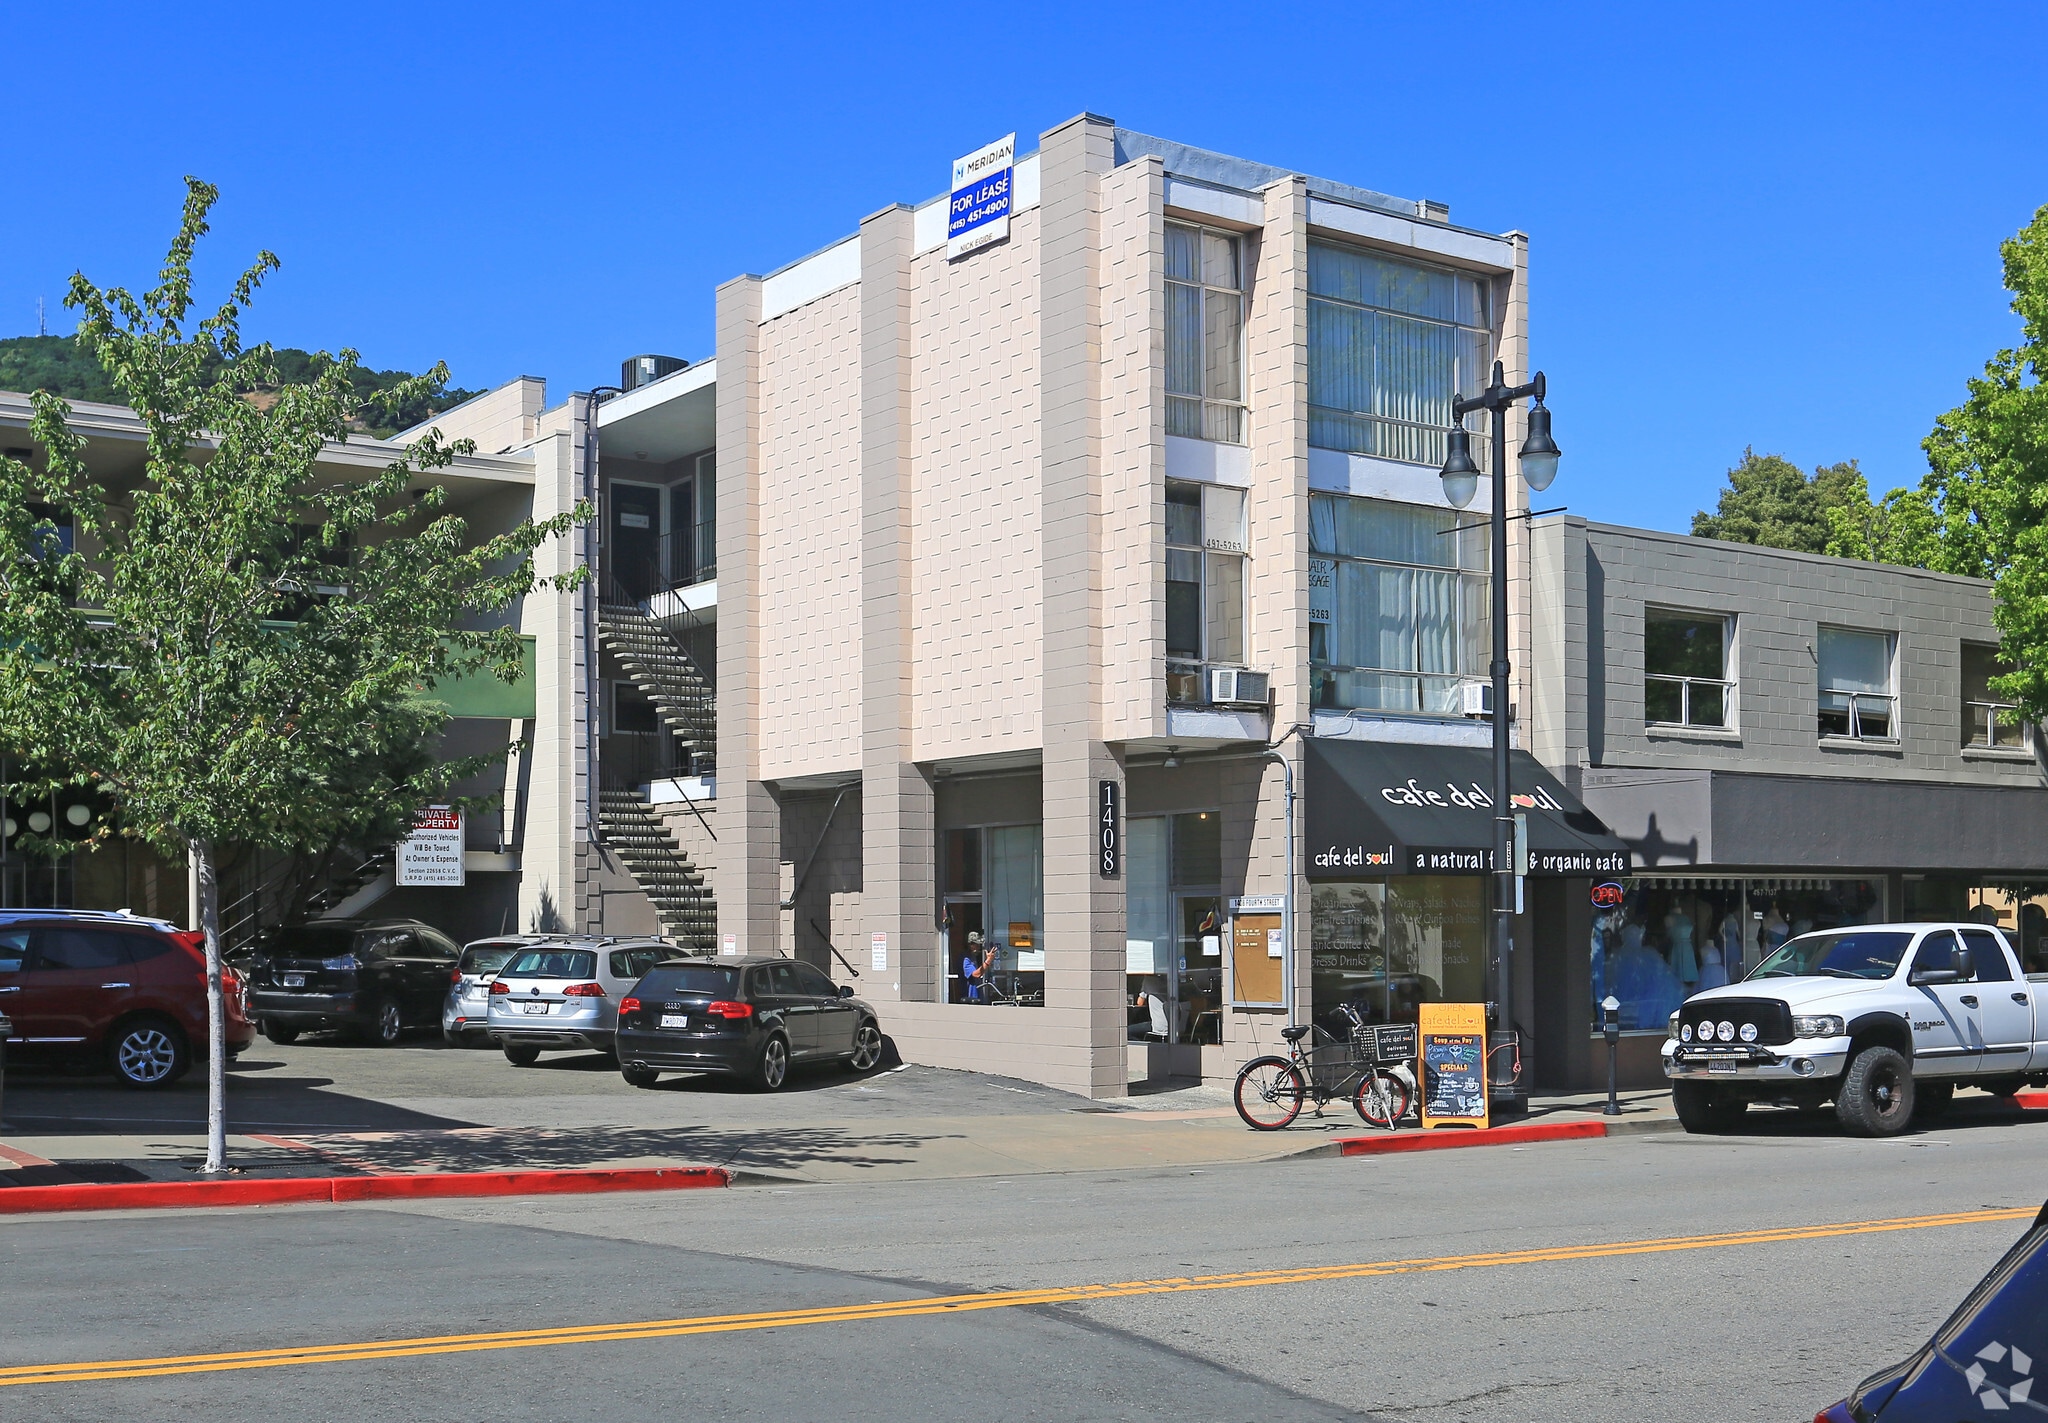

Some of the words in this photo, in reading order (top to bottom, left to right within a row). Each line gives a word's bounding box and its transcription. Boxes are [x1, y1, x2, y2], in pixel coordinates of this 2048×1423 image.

[967, 144, 1012, 174] MERIDIAN
[951, 194, 974, 215] FOR
[976, 178, 1009, 204] LEASE
[949, 218, 966, 232] (415)
[967, 197, 1008, 223] 451-4900
[1309, 561, 1326, 573] AIR
[1309, 575, 1330, 587] SSAGE
[1309, 609, 1329, 619] -5263
[1381, 778, 1448, 808] cafe
[1446, 781, 1494, 810] del
[411, 819, 458, 828] ROPERTY
[1103, 785, 1114, 871] 1408
[439, 833, 460, 841] Vehicles
[436, 855, 459, 863] Expense
[1315, 845, 1343, 866] cafe
[1343, 845, 1363, 866] del
[1416, 853, 1425, 868] a
[1430, 850, 1485, 869] natural
[1529, 851, 1539, 869] &
[1542, 851, 1591, 873] organic
[1595, 851, 1624, 870] cafe
[1591, 886, 1623, 903] OPEN
[1339, 953, 1367, 967] Drinks
[1439, 1063, 1469, 1071] SPECIALS
